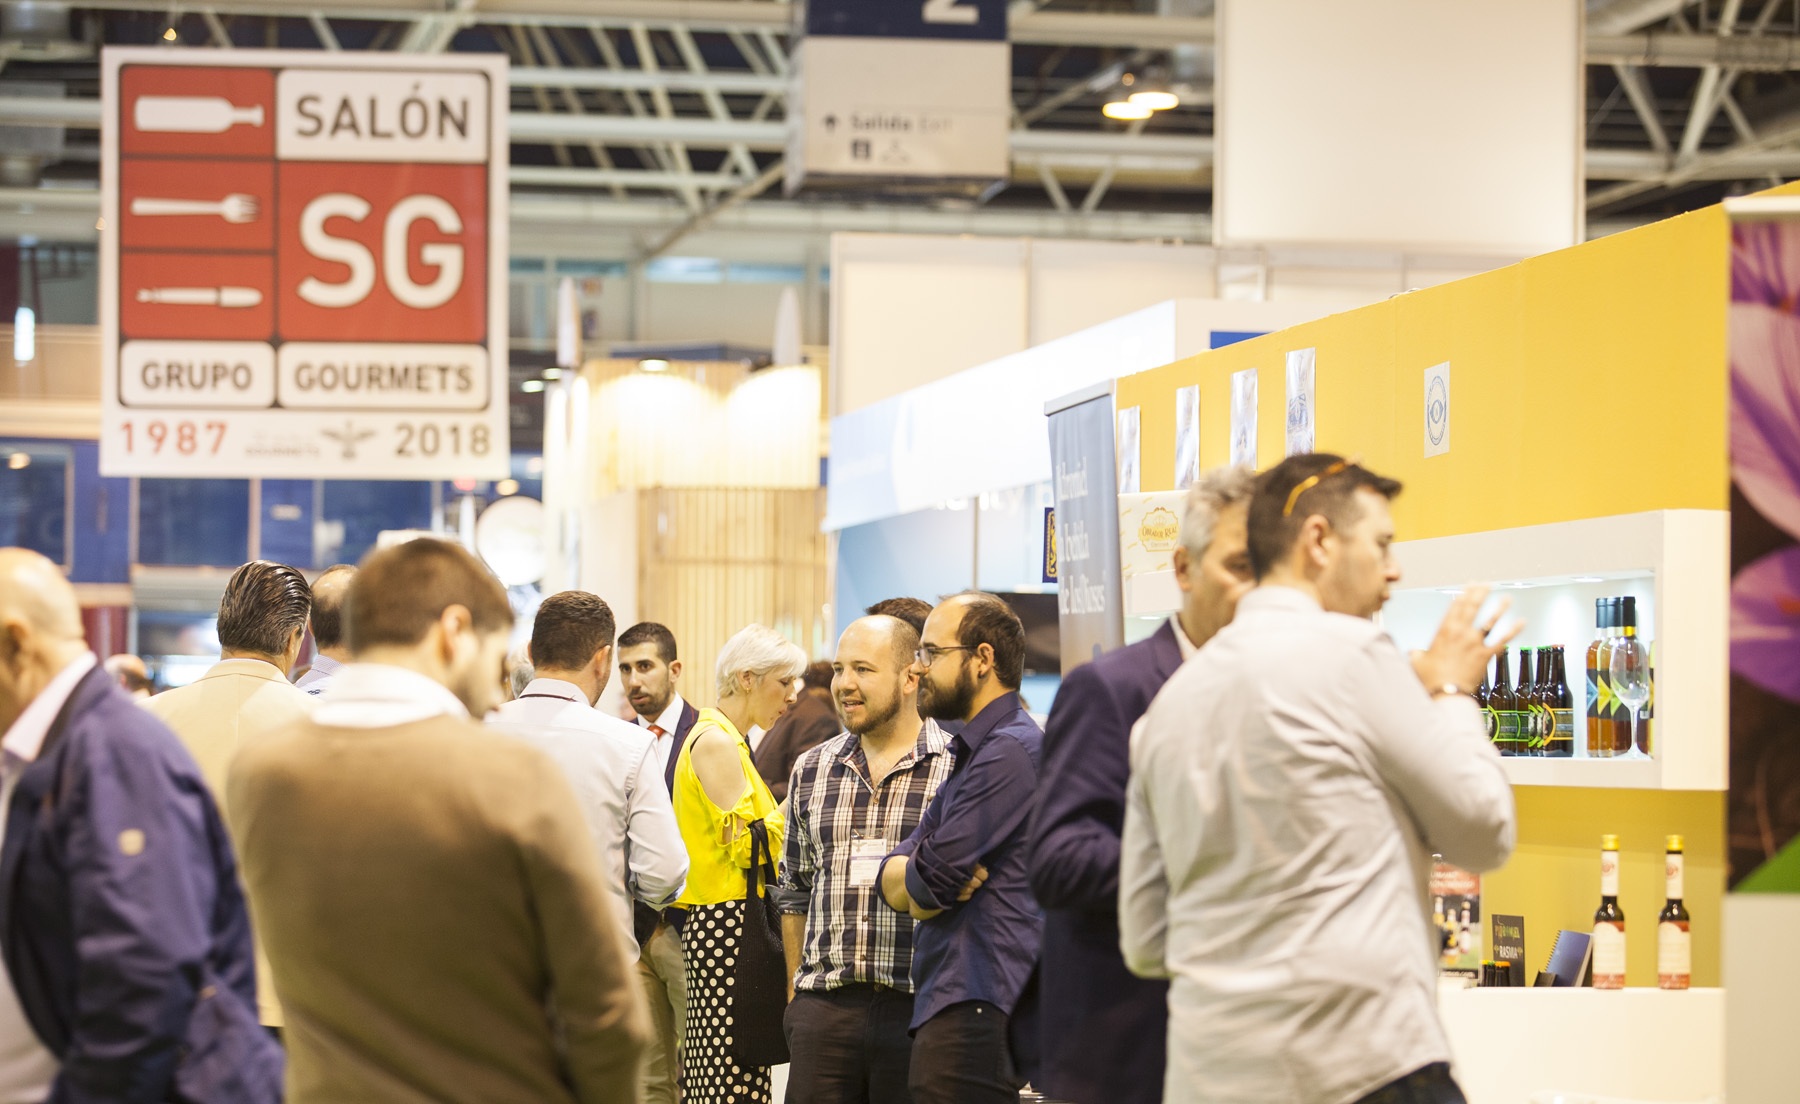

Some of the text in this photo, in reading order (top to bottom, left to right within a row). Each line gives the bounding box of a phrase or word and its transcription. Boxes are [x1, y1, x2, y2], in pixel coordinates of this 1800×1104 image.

[295, 82, 469, 140] SALÓN
[297, 192, 465, 309] SG
[141, 362, 473, 392] GRUPO GOURMETS
[121, 422, 228, 455] 1987
[395, 423, 491, 457] 2018
